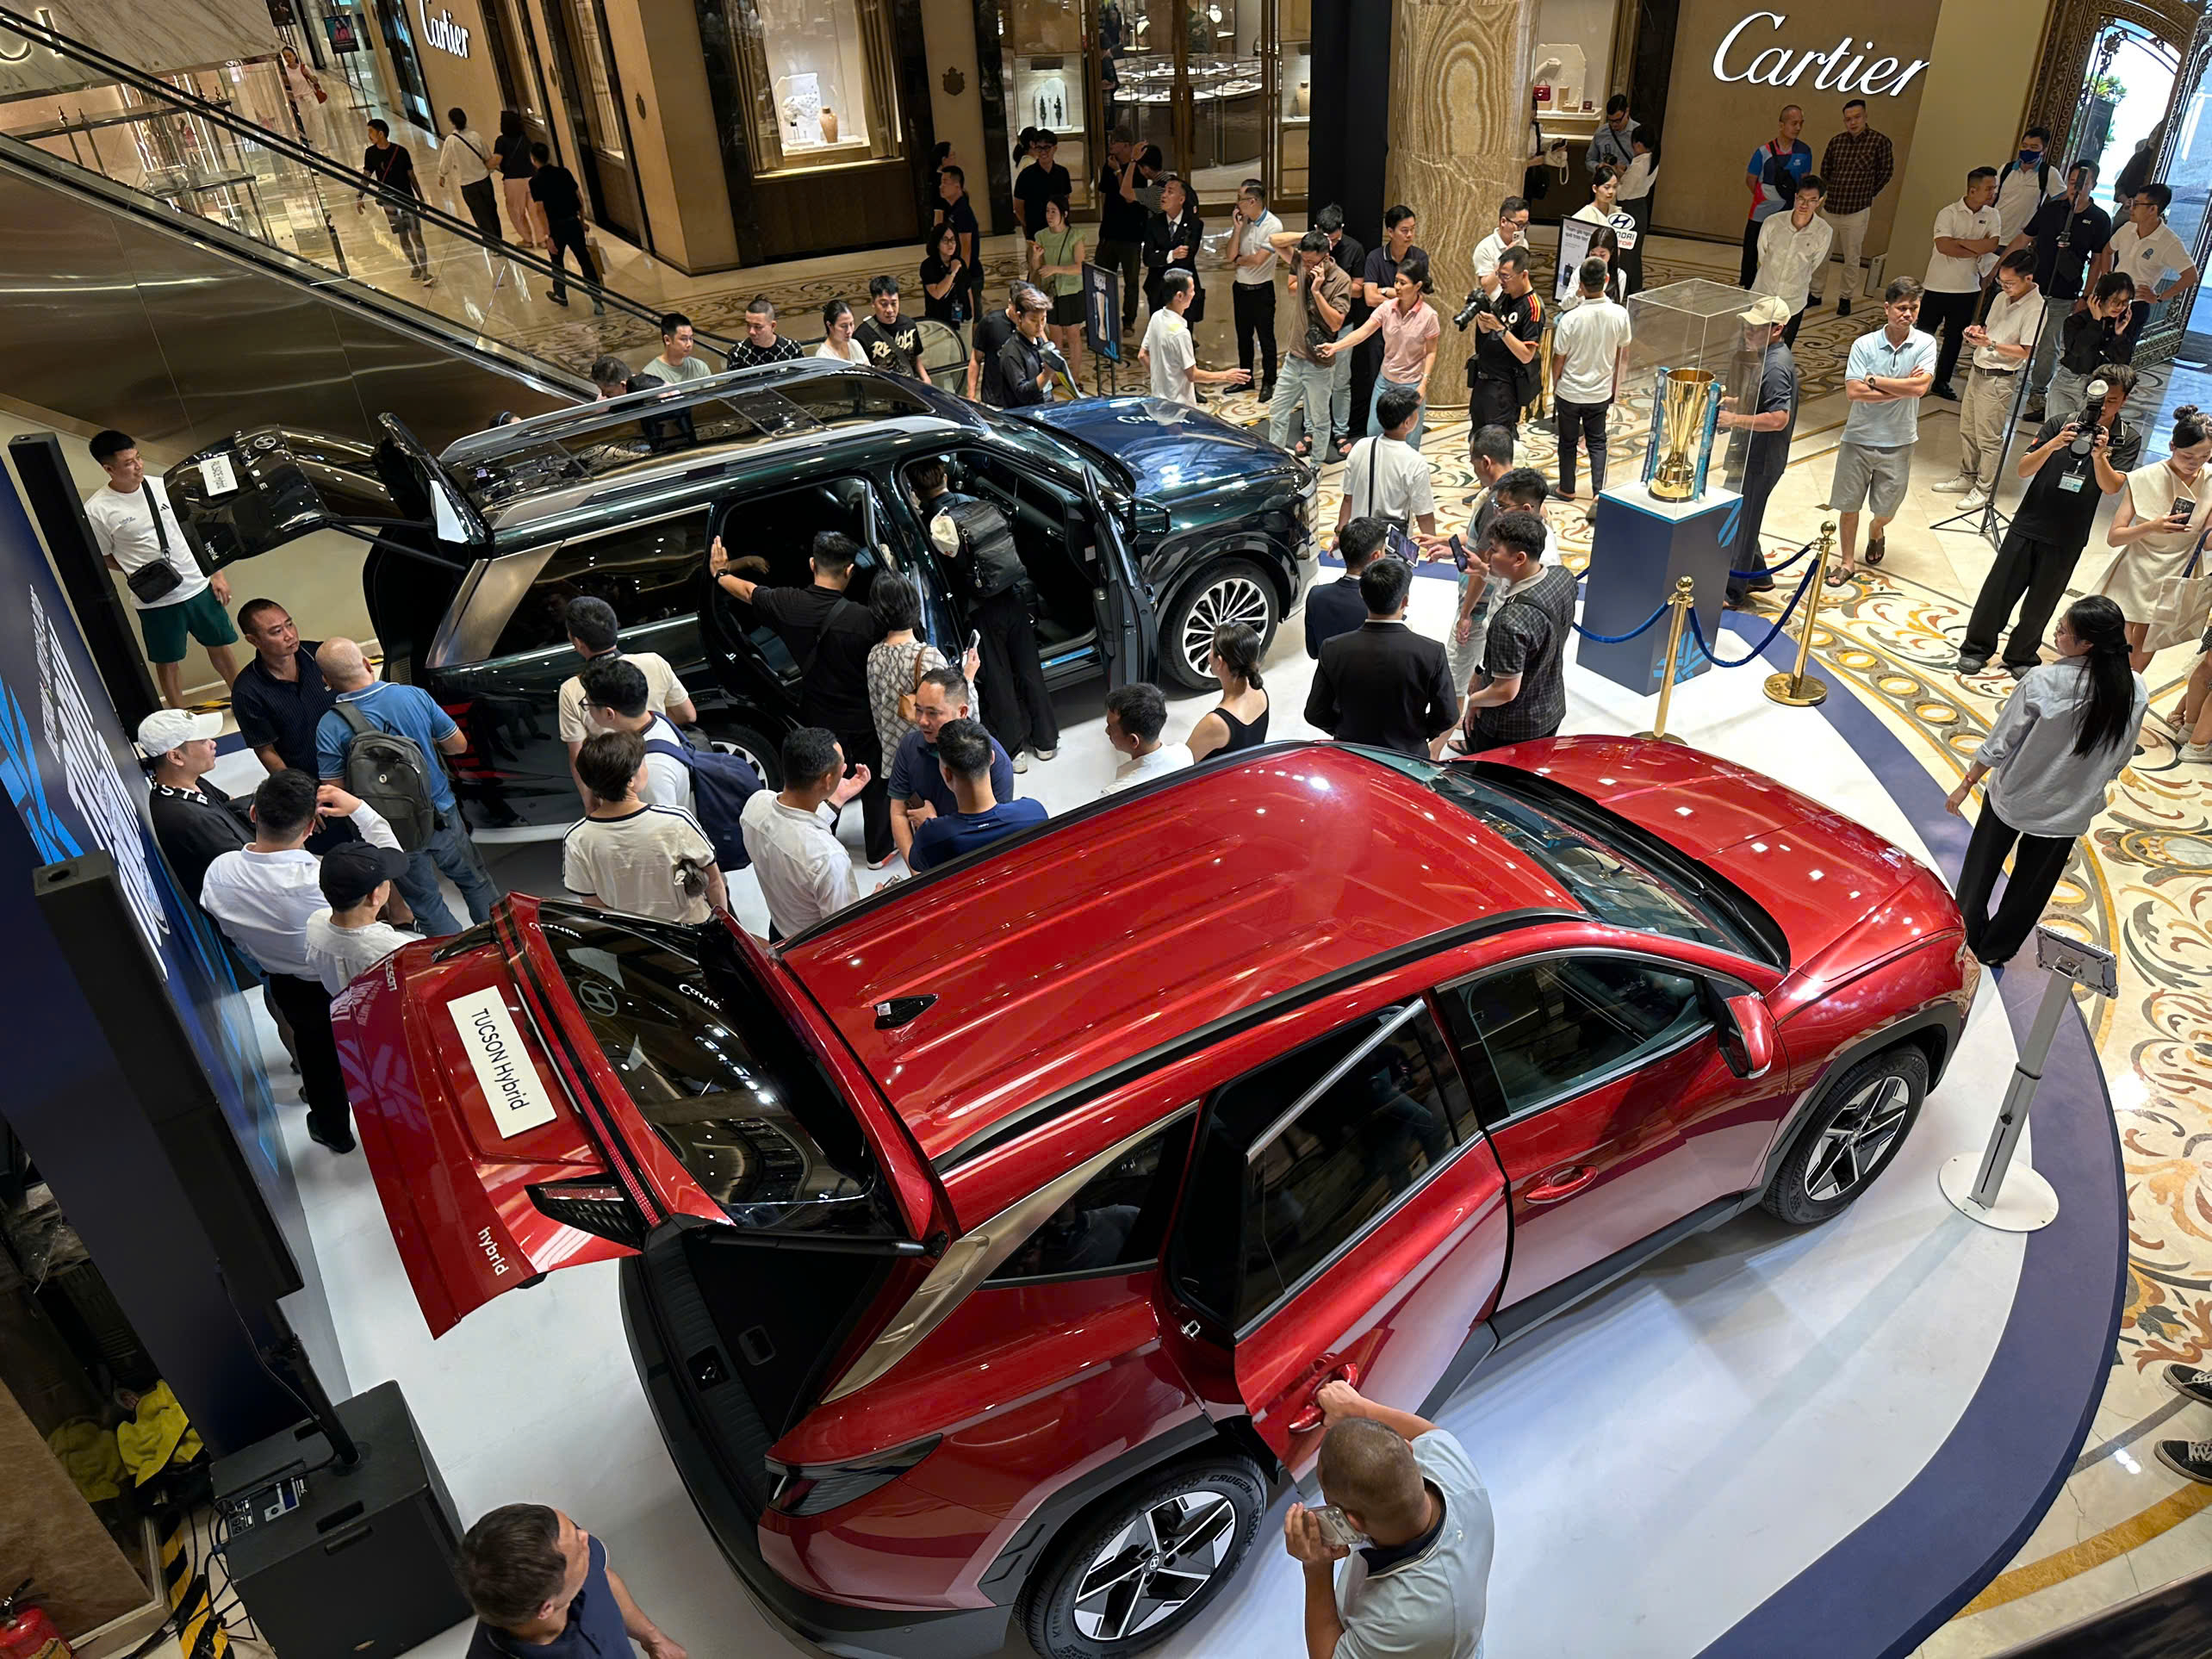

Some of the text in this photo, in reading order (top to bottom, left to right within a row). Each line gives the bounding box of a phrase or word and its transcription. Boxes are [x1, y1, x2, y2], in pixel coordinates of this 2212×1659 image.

[1712, 11, 1929, 96] Cartier
[47, 615, 115, 860] TROPHY
[471, 1008, 530, 1110] TUCSON Hybrid
[478, 1226, 510, 1277] hybrid
[1208, 1474, 1253, 1494] CRUGEN
